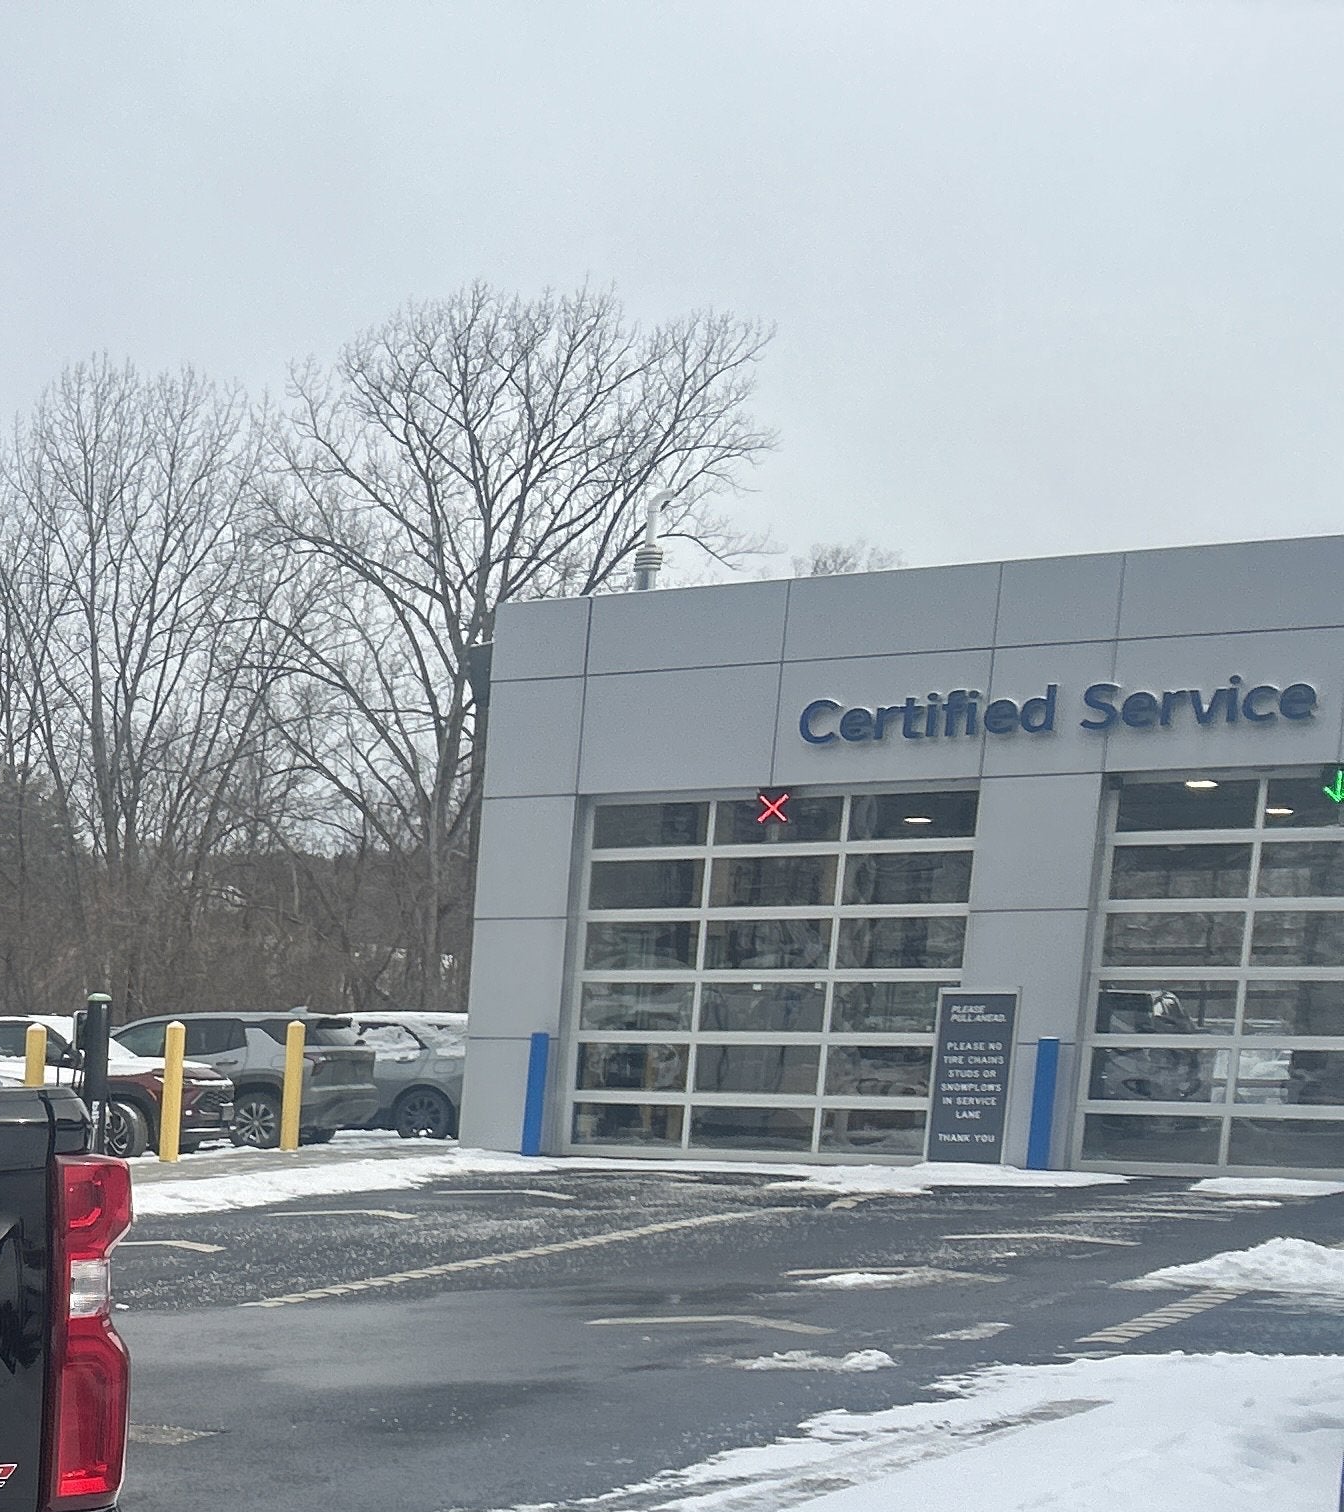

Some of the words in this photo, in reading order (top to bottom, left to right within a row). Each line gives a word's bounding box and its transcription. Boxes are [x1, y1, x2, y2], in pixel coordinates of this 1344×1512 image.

[799, 683, 1060, 746] Certified
[1079, 675, 1319, 731] Service
[946, 1041, 985, 1051] PLEASE
[988, 1041, 1003, 1051] NO
[943, 1055, 965, 1065] TIRE
[968, 1055, 1004, 1065] CHAINS
[948, 1069, 980, 1078] STUDS
[982, 1069, 997, 1078] OR
[941, 1083, 1002, 1092] SNOWPLOWS
[942, 1096, 953, 1105] IN
[956, 1096, 997, 1106] SERVICE
[955, 1110, 981, 1119] LANE
[938, 1133, 970, 1143] THANK
[974, 1133, 995, 1143] YOU
